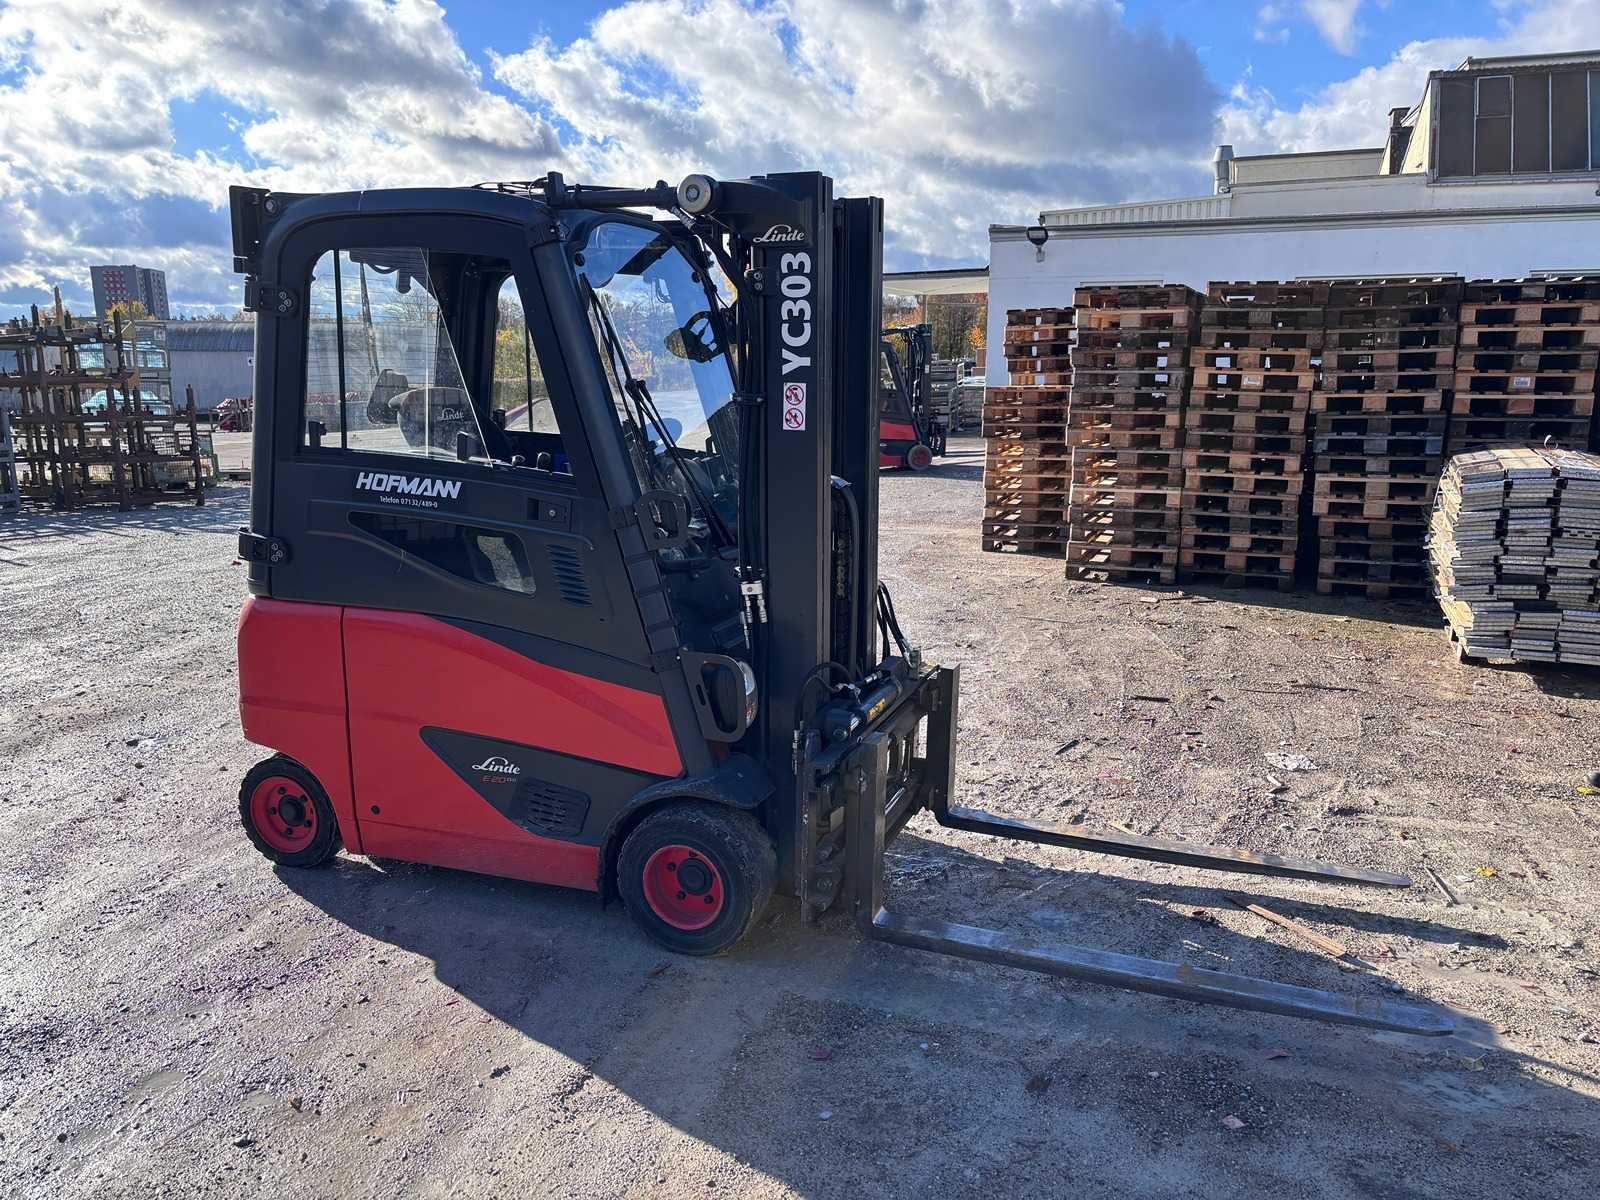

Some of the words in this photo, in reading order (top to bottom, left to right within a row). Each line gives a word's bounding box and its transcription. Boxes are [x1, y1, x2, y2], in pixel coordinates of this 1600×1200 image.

[752, 223, 805, 243] Linde
[780, 251, 812, 376] YC303
[355, 471, 462, 499] HOFMANN
[379, 495, 400, 505] Telefon
[471, 756, 521, 775] Linde
